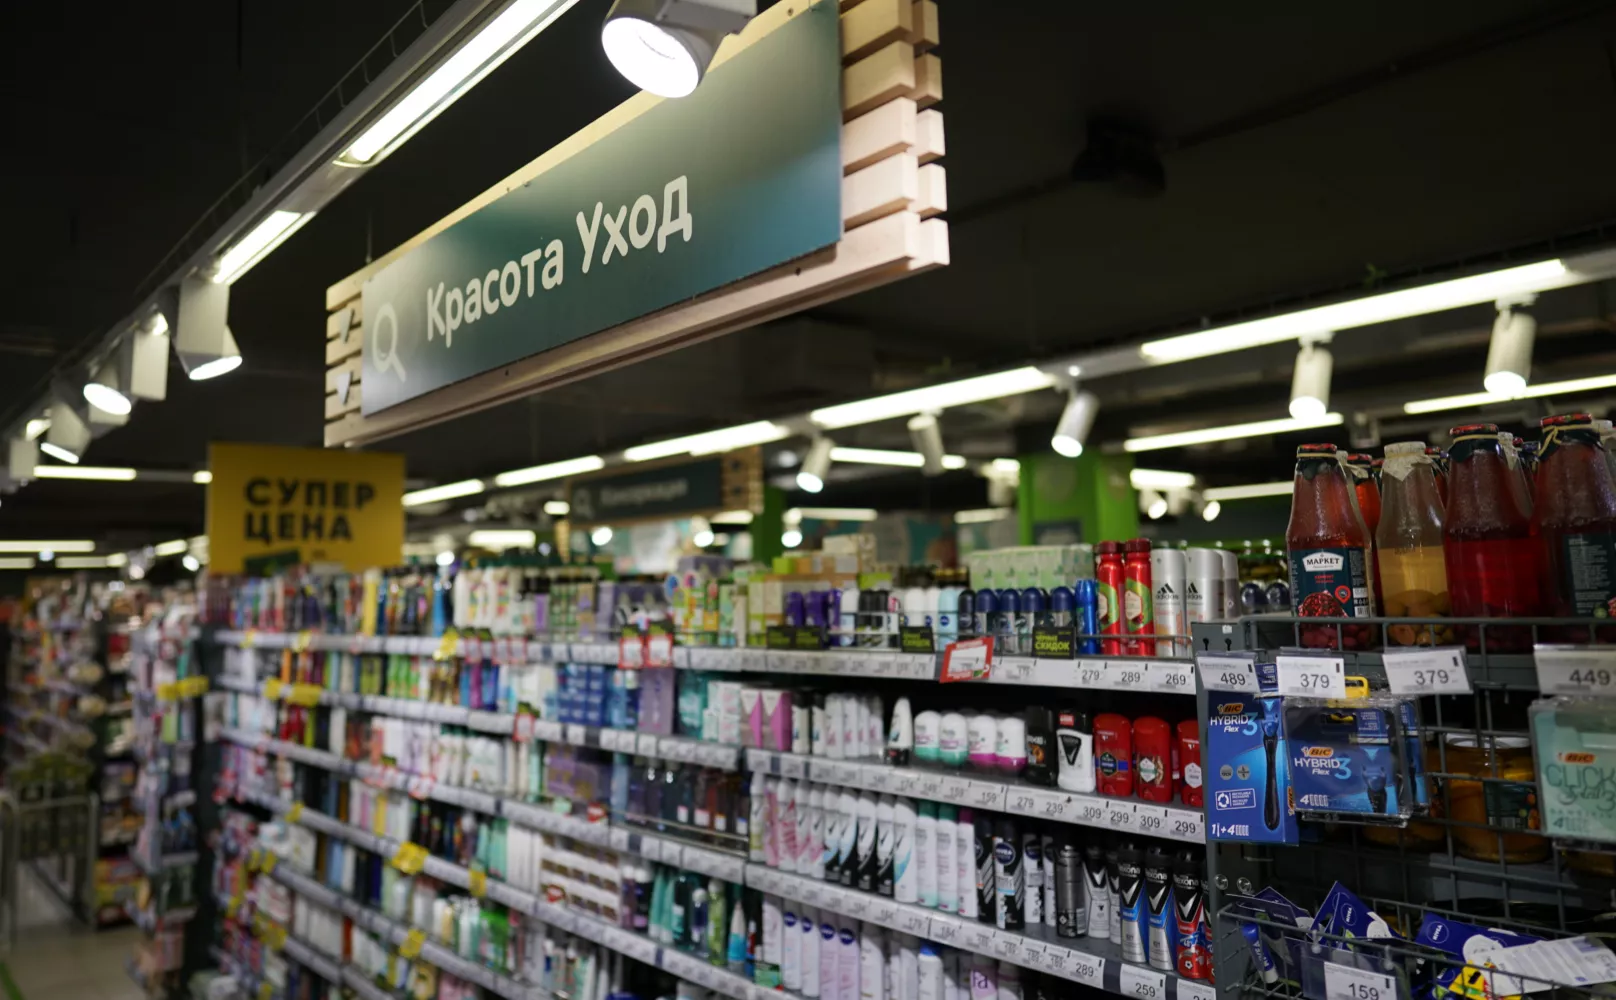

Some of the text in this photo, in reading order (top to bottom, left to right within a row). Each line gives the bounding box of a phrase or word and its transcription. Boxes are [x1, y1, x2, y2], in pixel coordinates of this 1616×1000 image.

[426, 174, 693, 348] Красота Уход
[245, 478, 376, 510] СУПЕР
[245, 511, 353, 545] ЦЕНА
[1306, 557, 1340, 566] МАРКЕТ
[1081, 669, 1100, 682] 279
[1121, 671, 1141, 684] 289
[1165, 673, 1187, 687] 269
[1220, 672, 1246, 686] 489
[1300, 673, 1330, 689] 379
[1414, 669, 1449, 686] 379
[1569, 669, 1611, 686] 449
[1209, 711, 1259, 736] HYBRID 3
[1223, 725, 1240, 734] Flex
[1310, 747, 1331, 756] BIC
[1294, 757, 1352, 780] HYBRID 3
[1311, 767, 1330, 776] Flex
[981, 791, 998, 803] 159
[1016, 795, 1034, 808] 279
[1300, 794, 1309, 805] 4
[1046, 802, 1063, 814] 239
[1083, 806, 1102, 819] 309
[1110, 810, 1130, 824] 299
[1140, 815, 1161, 829] 309
[1174, 820, 1197, 834] 299
[1432, 924, 1443, 941] NIVEA
[1075, 962, 1095, 978] 289
[1135, 982, 1156, 998] 259
[1348, 982, 1380, 1000] 159
